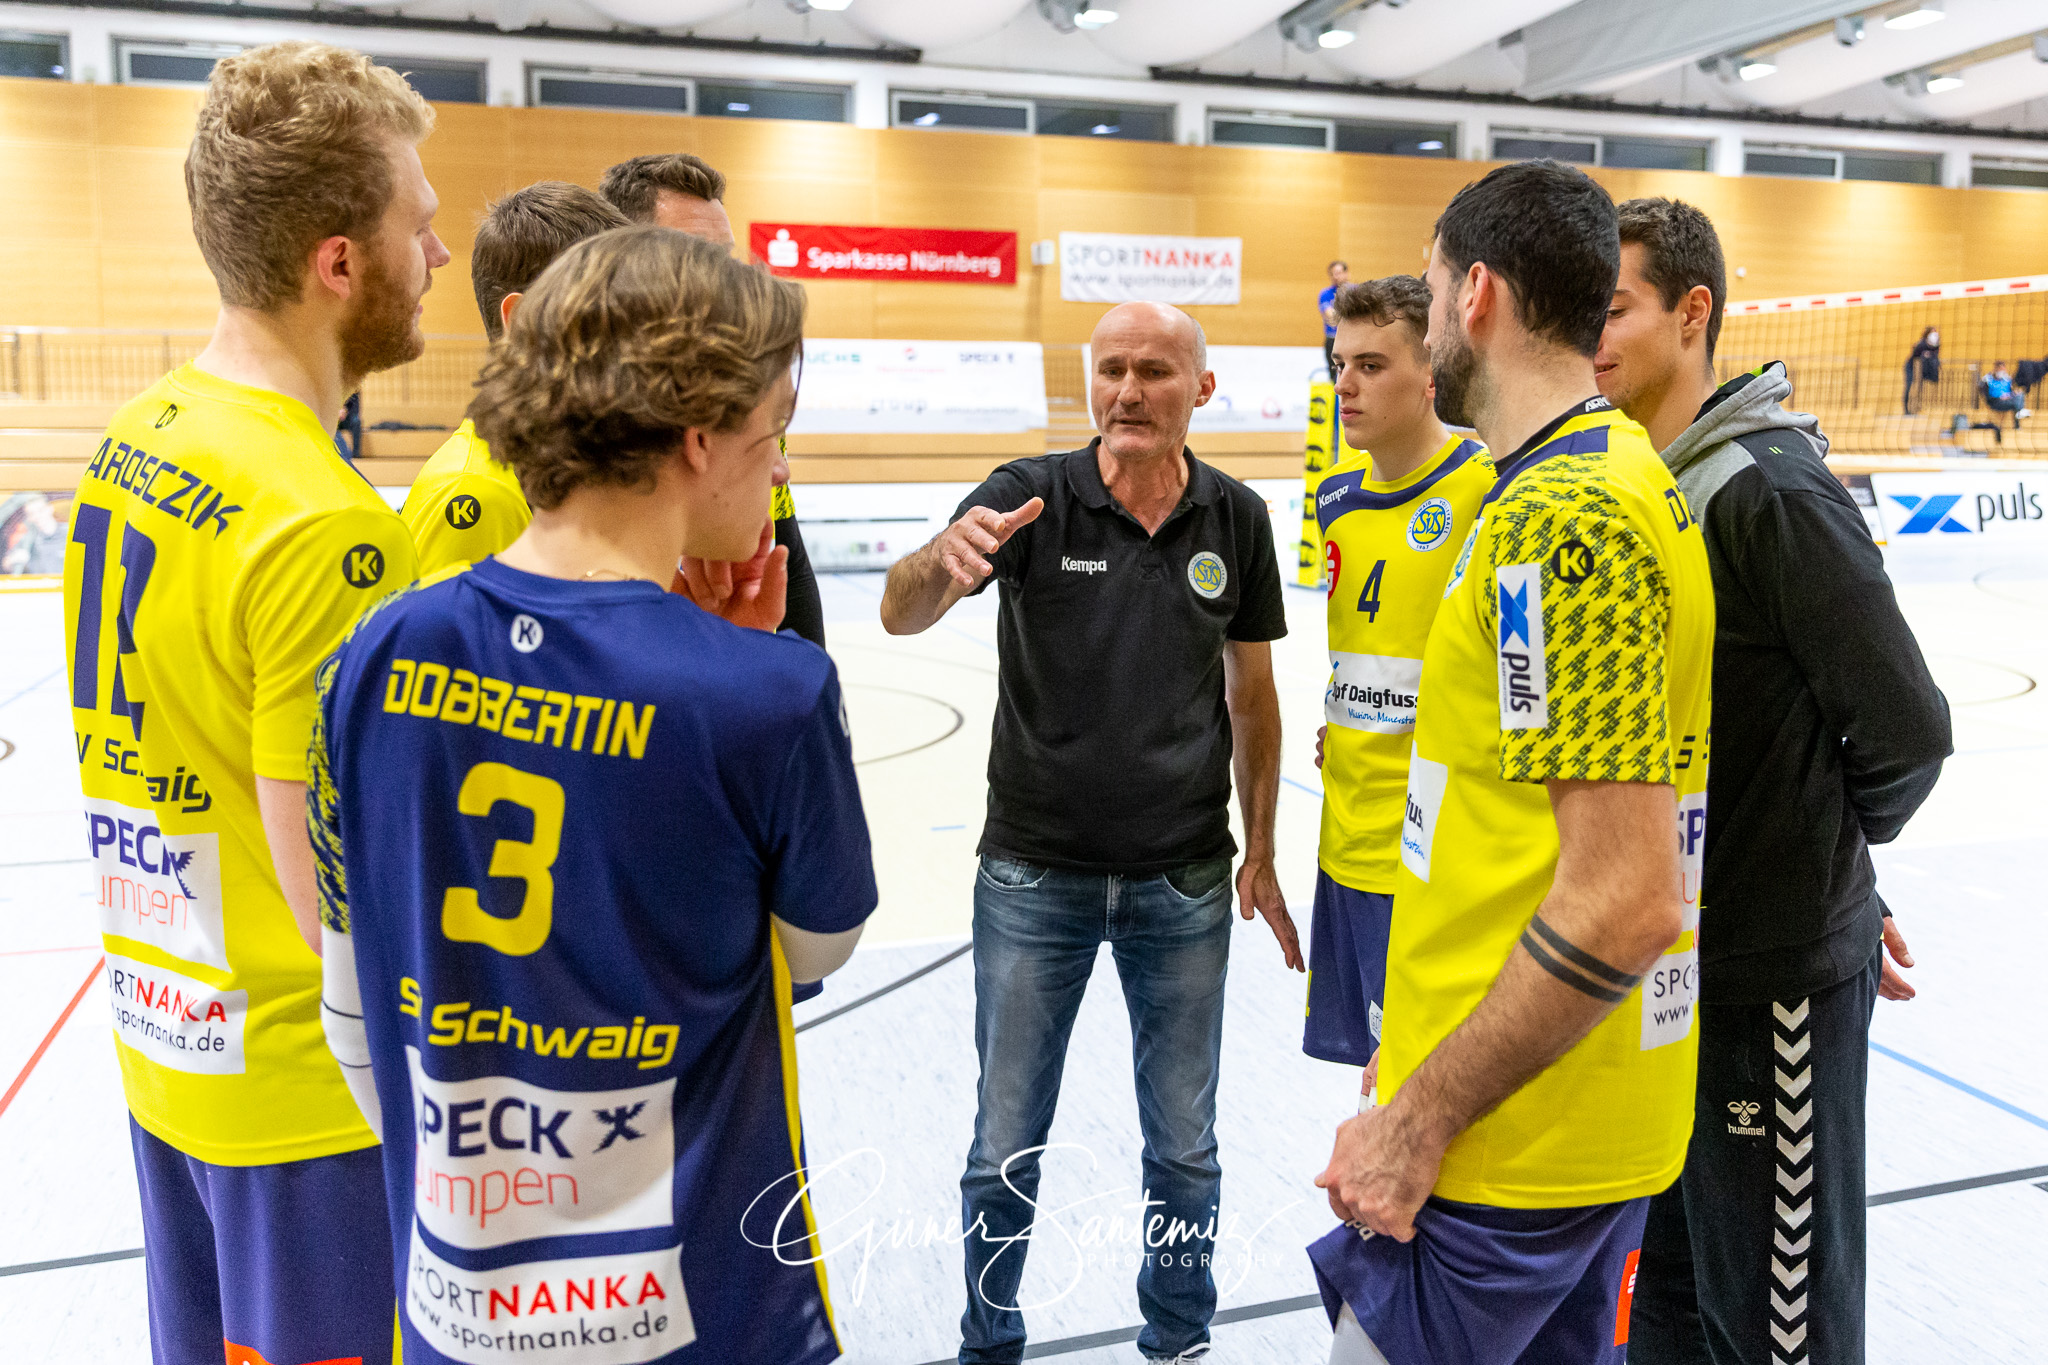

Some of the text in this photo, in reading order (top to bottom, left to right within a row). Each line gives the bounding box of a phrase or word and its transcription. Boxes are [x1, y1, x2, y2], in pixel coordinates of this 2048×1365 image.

[806, 246, 1002, 278] Sparkasse Nürnberg
[1067, 244, 1233, 268] SPORTNANKA
[1318, 485, 1349, 509] Kempa
[1977, 481, 2044, 534] puls
[1062, 556, 1107, 576] Kempa
[1357, 559, 1387, 623] 4
[383, 658, 656, 760] DOBBERTIN
[1501, 651, 1540, 714] puls
[441, 761, 566, 957] 3
[428, 1001, 681, 1070] Schwaig
[420, 1091, 574, 1160] PECK
[1727, 1122, 1766, 1137] hummel
[413, 1252, 667, 1321] PORTNANKA
